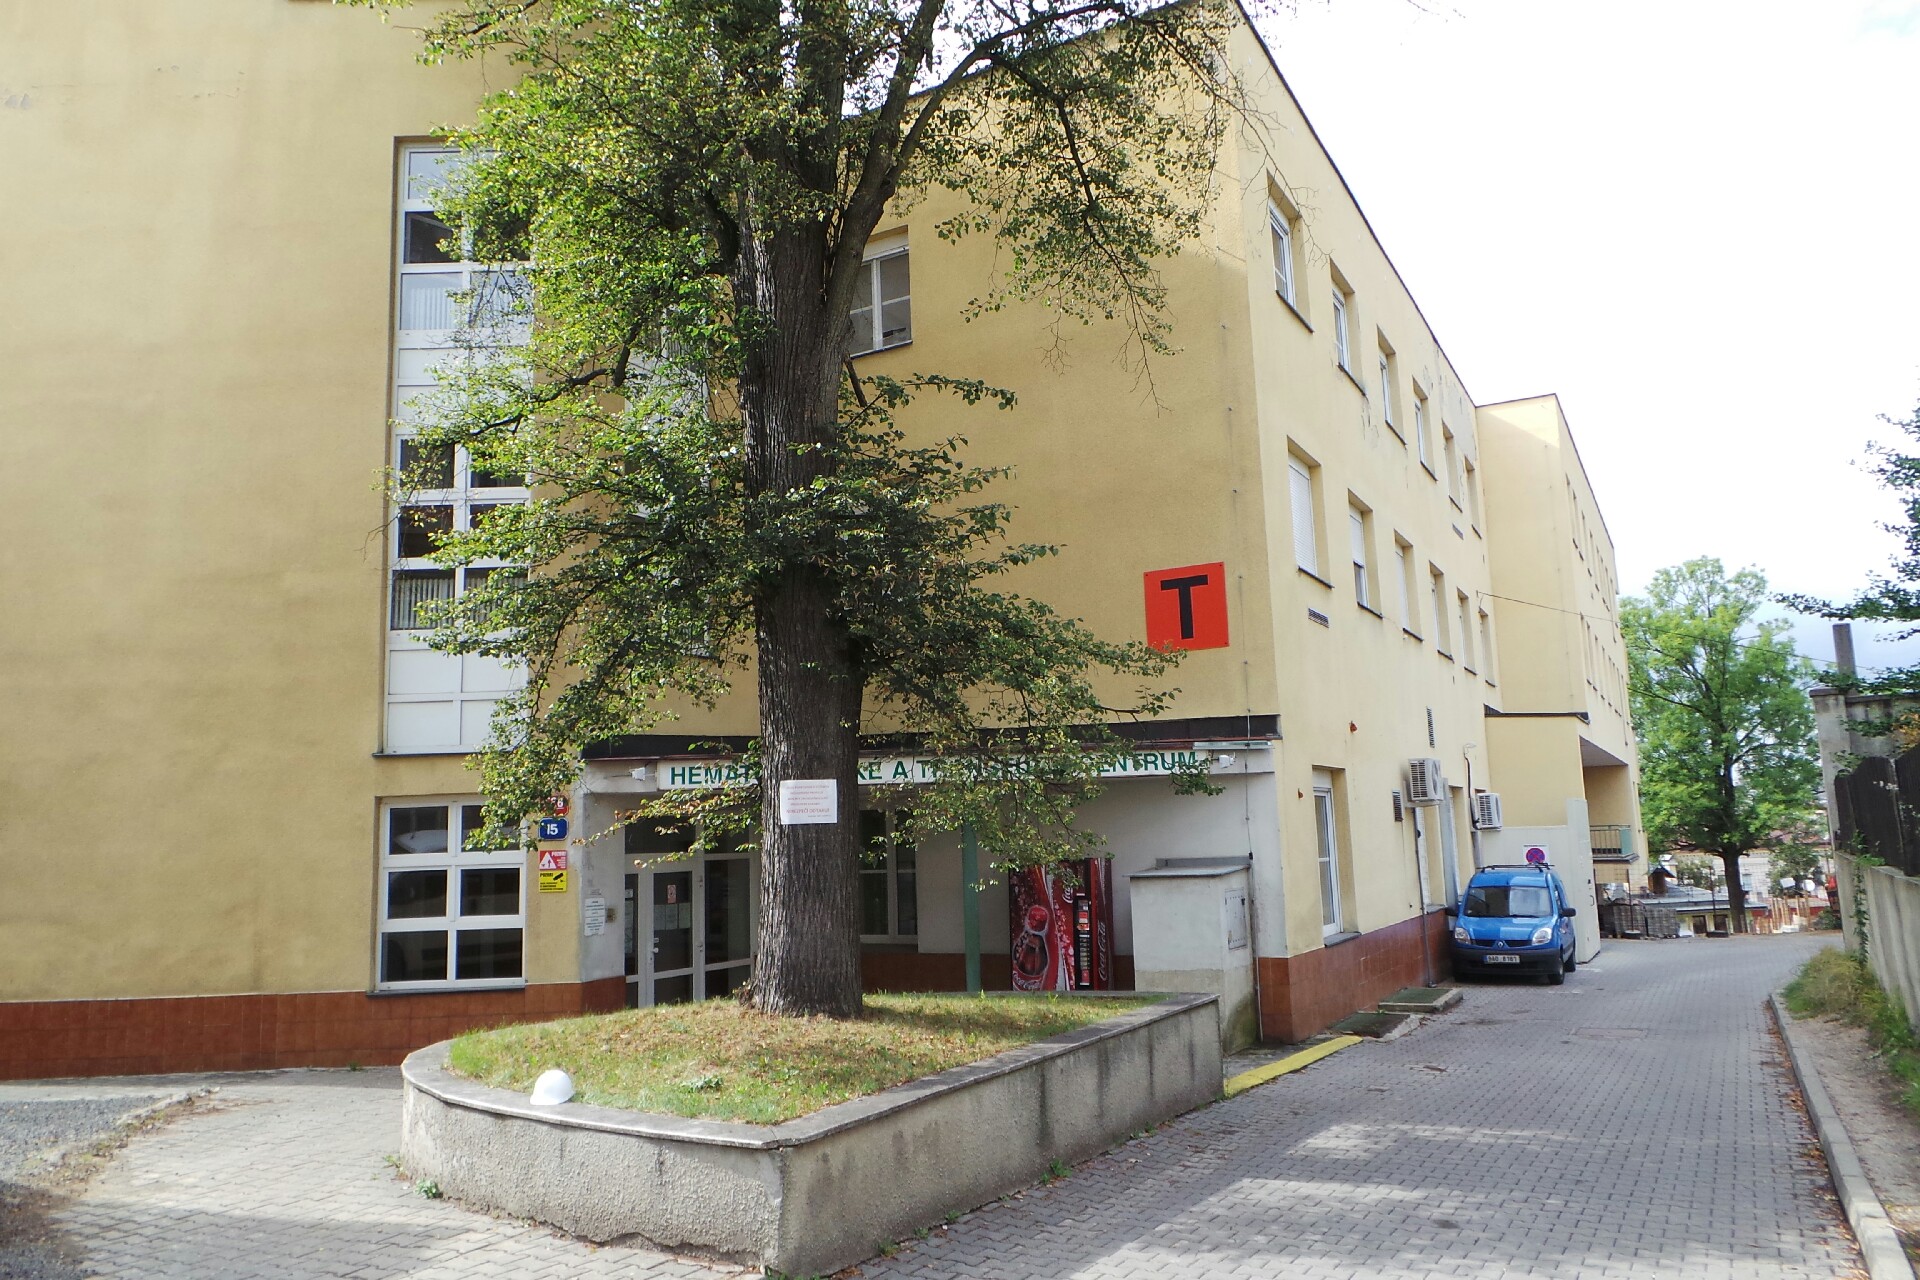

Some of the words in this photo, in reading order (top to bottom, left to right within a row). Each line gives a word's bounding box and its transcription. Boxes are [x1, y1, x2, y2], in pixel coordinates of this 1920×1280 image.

[1160, 574, 1209, 640] T
[892, 760, 908, 779] A
[546, 823, 559, 835] 15
